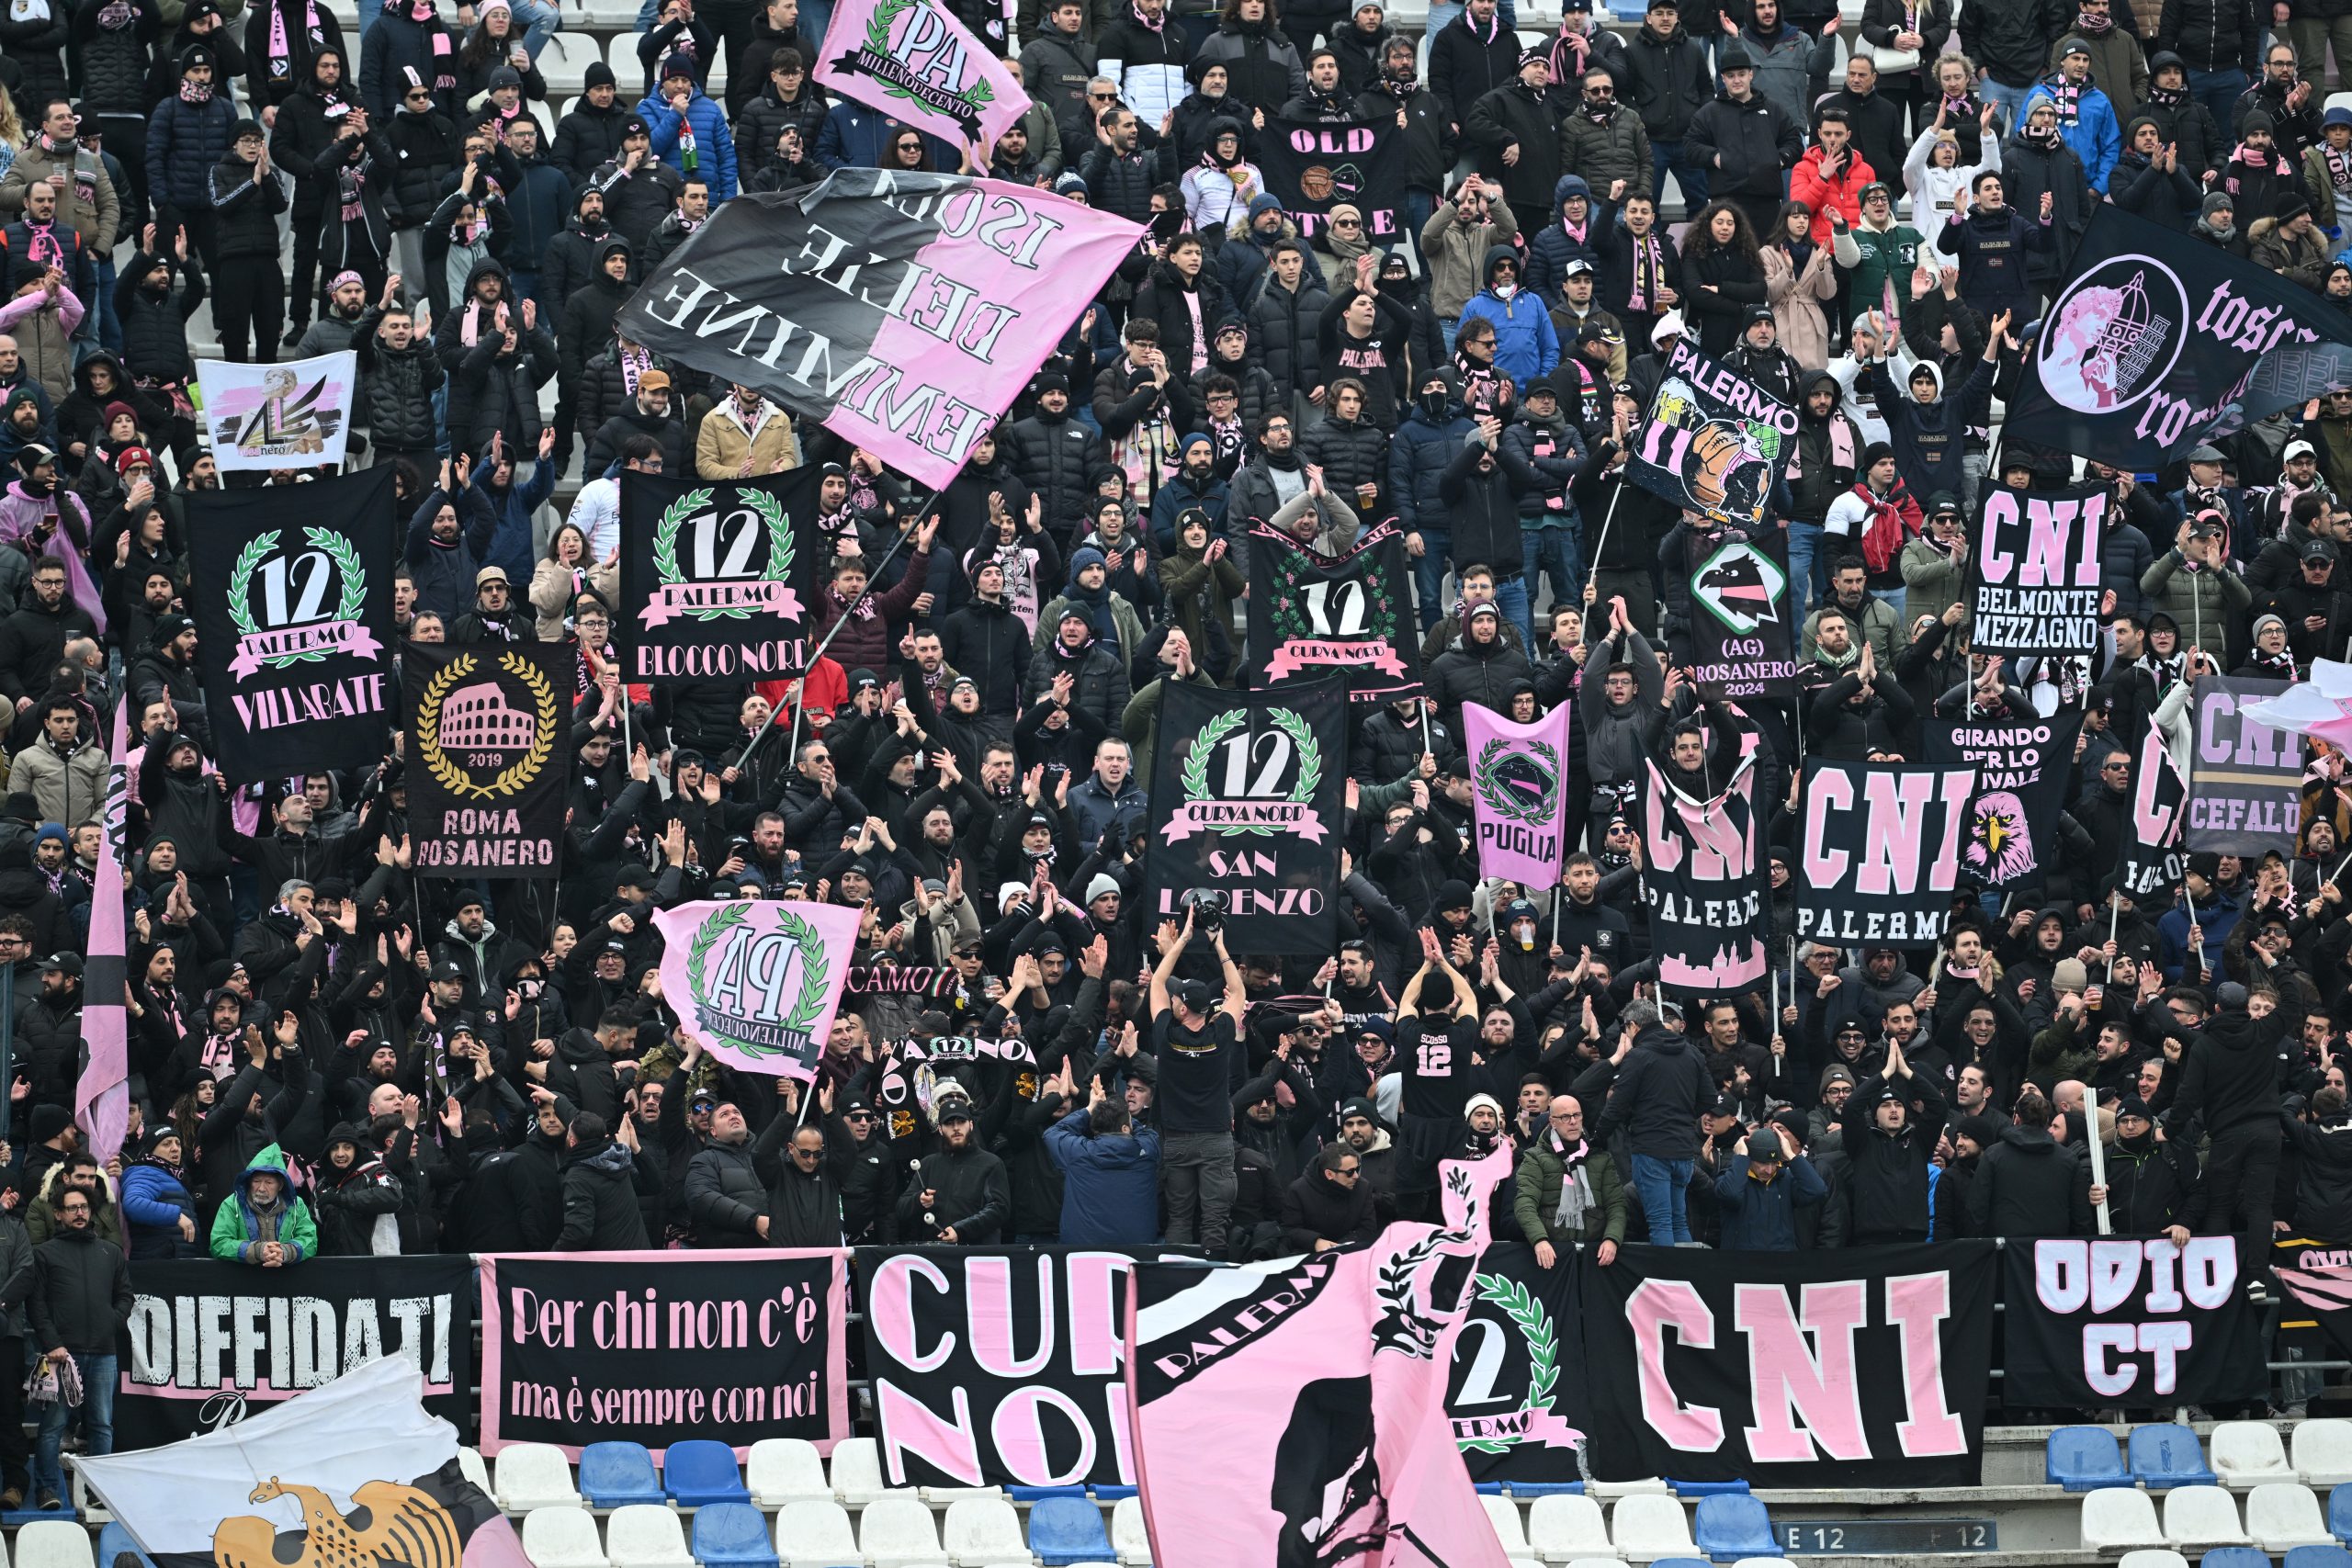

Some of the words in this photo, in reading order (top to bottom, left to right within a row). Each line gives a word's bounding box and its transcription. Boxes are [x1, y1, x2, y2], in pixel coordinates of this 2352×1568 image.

[891, 0, 969, 96] PA
[1290, 127, 1374, 153] OLD
[1669, 344, 1799, 436] PALERMO
[689, 509, 761, 579] 12
[1980, 490, 2107, 588] CNI
[258, 551, 334, 626] 12
[664, 582, 781, 606] PALERMO
[1978, 586, 2098, 616] BELMONTE
[1299, 581, 1370, 636] 12
[246, 623, 356, 656] PALERMO
[1973, 614, 2098, 649] MEZZAGNO
[638, 644, 736, 677] BLOCCO
[742, 638, 807, 671] NORD
[1289, 646, 1340, 660] CURVA
[1344, 645, 1385, 660] NORD
[1721, 638, 1765, 660] (AG)
[1696, 660, 1796, 683] ROSANERO
[232, 673, 385, 734] VILLABATE
[1724, 682, 1765, 697] 2024
[1951, 726, 2052, 747] GIRANDO
[468, 752, 503, 769] 2019
[1221, 729, 1292, 797] 12
[1962, 749, 2004, 770] PER
[2007, 749, 2040, 768] LO
[1982, 767, 2042, 790] IVALE
[443, 808, 521, 835] ROMA
[1187, 804, 1252, 822] CURVA
[1255, 804, 1306, 823] NORD
[2190, 791, 2301, 834] CEFALÙ
[1480, 822, 1556, 863] PUGLIA
[1803, 766, 1976, 895] CNI
[416, 839, 554, 867] ROSANERO
[1208, 850, 1277, 879] SAN
[842, 966, 933, 993] CAMO
[939, 1039, 962, 1052] 12
[1420, 1033, 1448, 1044] SCOSSO
[1416, 1044, 1452, 1077] 12
[2034, 1235, 2238, 1314] ODIO
[511, 1286, 585, 1349] Per
[593, 1287, 656, 1350] chi
[669, 1296, 746, 1349] non
[760, 1281, 818, 1349] c'è
[126, 1292, 453, 1389] DIFFIDATI
[1453, 1317, 1513, 1406] 2
[1624, 1269, 1969, 1462] CNI
[2082, 1320, 2193, 1396] CT
[511, 1381, 562, 1420] ma
[566, 1377, 584, 1424] è
[589, 1387, 707, 1426] sempre
[712, 1385, 766, 1424] con
[773, 1371, 818, 1419] noi
[1450, 1410, 1534, 1440] ERMO
[1788, 1528, 1800, 1550] E
[1814, 1528, 1845, 1551] 12
[1955, 1525, 1987, 1547] 12
